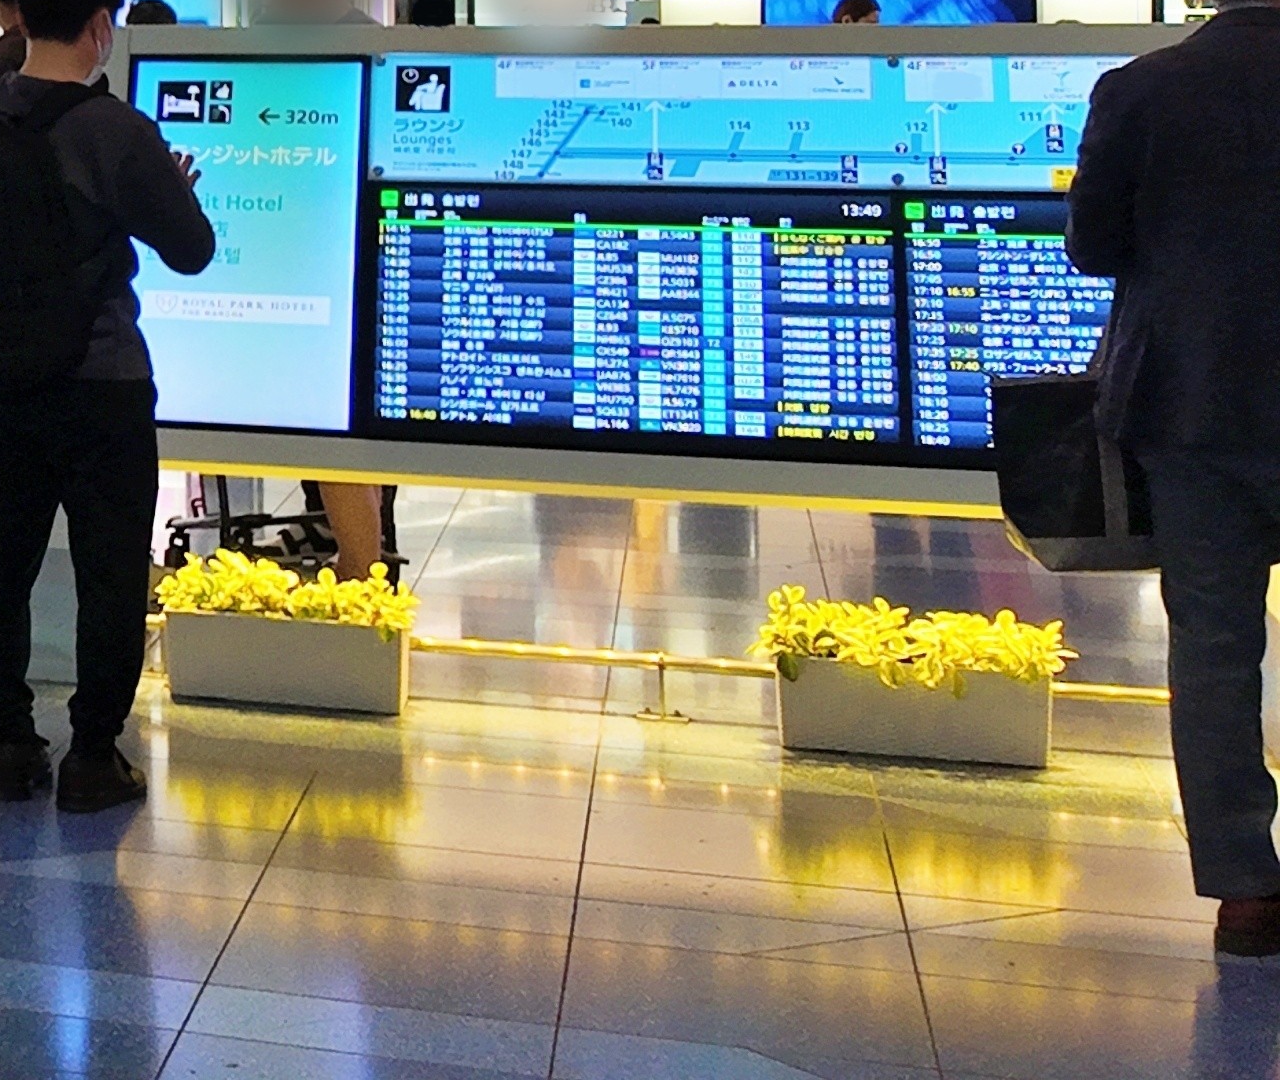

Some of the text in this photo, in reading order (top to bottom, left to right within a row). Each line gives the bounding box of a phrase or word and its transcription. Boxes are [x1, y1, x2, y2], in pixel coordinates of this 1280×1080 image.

[907, 61, 922, 70] 4F
[1011, 61, 1027, 70] 4F
[552, 100, 572, 109] 142
[621, 102, 641, 111] 141
[285, 109, 339, 124] 320m
[544, 110, 565, 118] 143
[1019, 112, 1042, 121] 111
[393, 117, 465, 133] ラウンジ
[537, 119, 558, 128] 144
[611, 118, 632, 127] 140
[729, 121, 751, 130] 114
[788, 121, 809, 131] 113
[905, 122, 928, 132] 112
[393, 133, 452, 148] Lounges
[521, 137, 542, 147] 146
[169, 144, 337, 167] ランジットホテル
[511, 149, 532, 158] 147
[503, 160, 524, 169] 148
[226, 195, 282, 211] Hotel
[841, 204, 882, 217] 13:49
[946, 287, 976, 296] 16:55
[182, 299, 315, 312] ROYAL PARK HOTEL
[950, 361, 980, 371] 17:40
